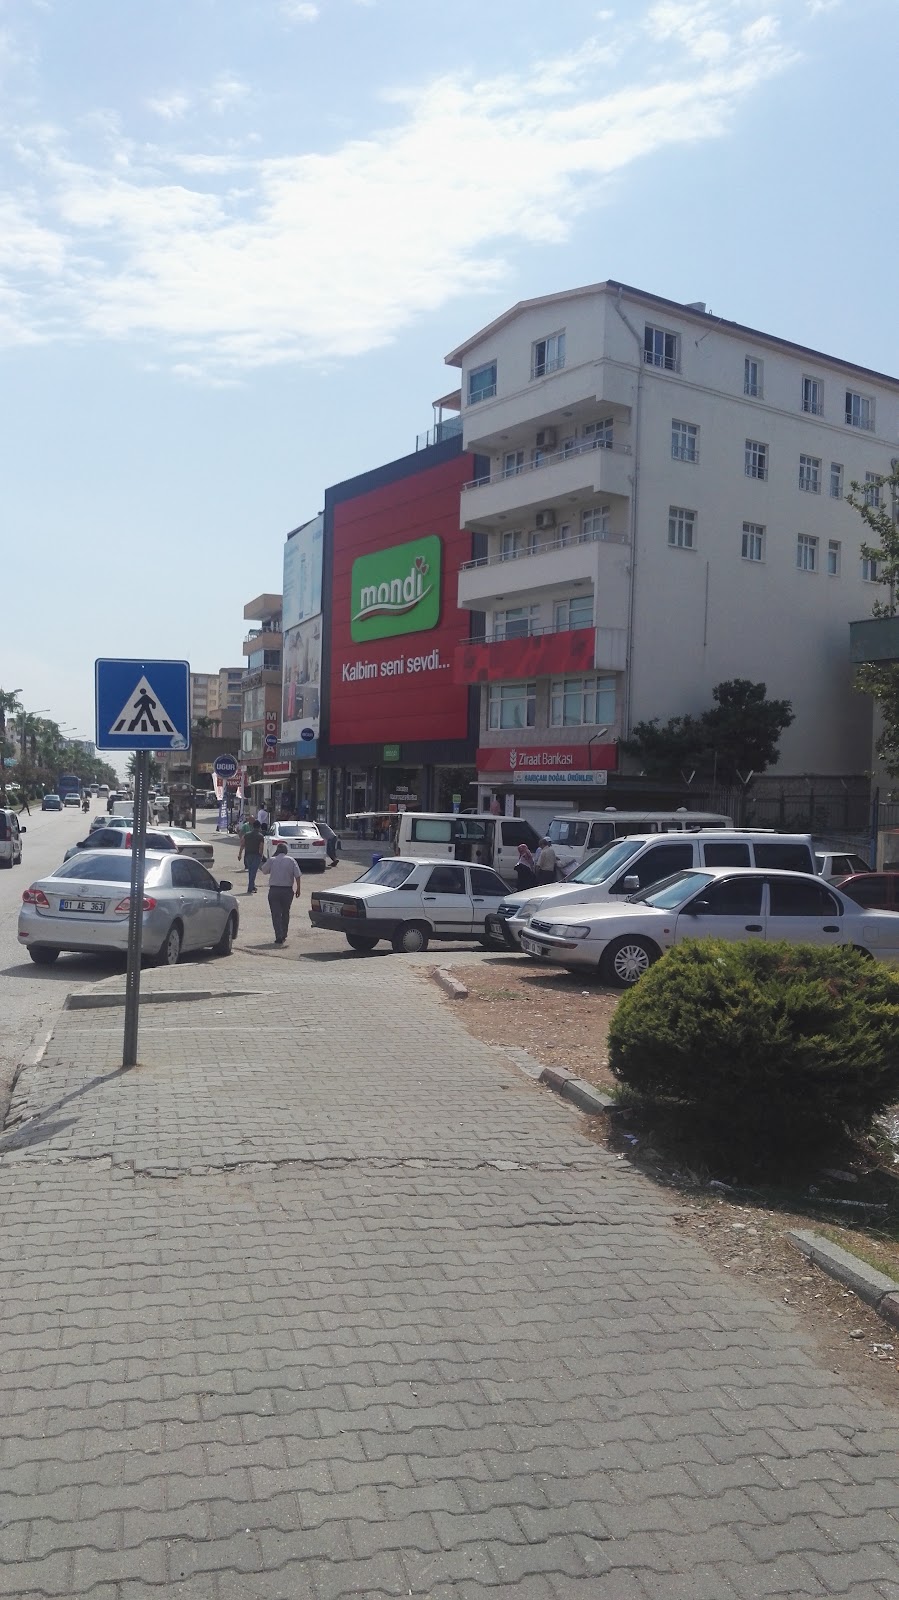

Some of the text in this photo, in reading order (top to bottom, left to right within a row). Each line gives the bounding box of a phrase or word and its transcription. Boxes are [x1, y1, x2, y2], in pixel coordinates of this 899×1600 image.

[360, 567, 422, 610] mondi
[342, 648, 450, 682] Kalbim seni sevdi...
[266, 711, 277, 753] MOA
[518, 752, 573, 766] Ziraat Bankası
[548, 773, 567, 782] DOĞAL
[77, 902, 86, 910] AE
[90, 903, 103, 911] 363
